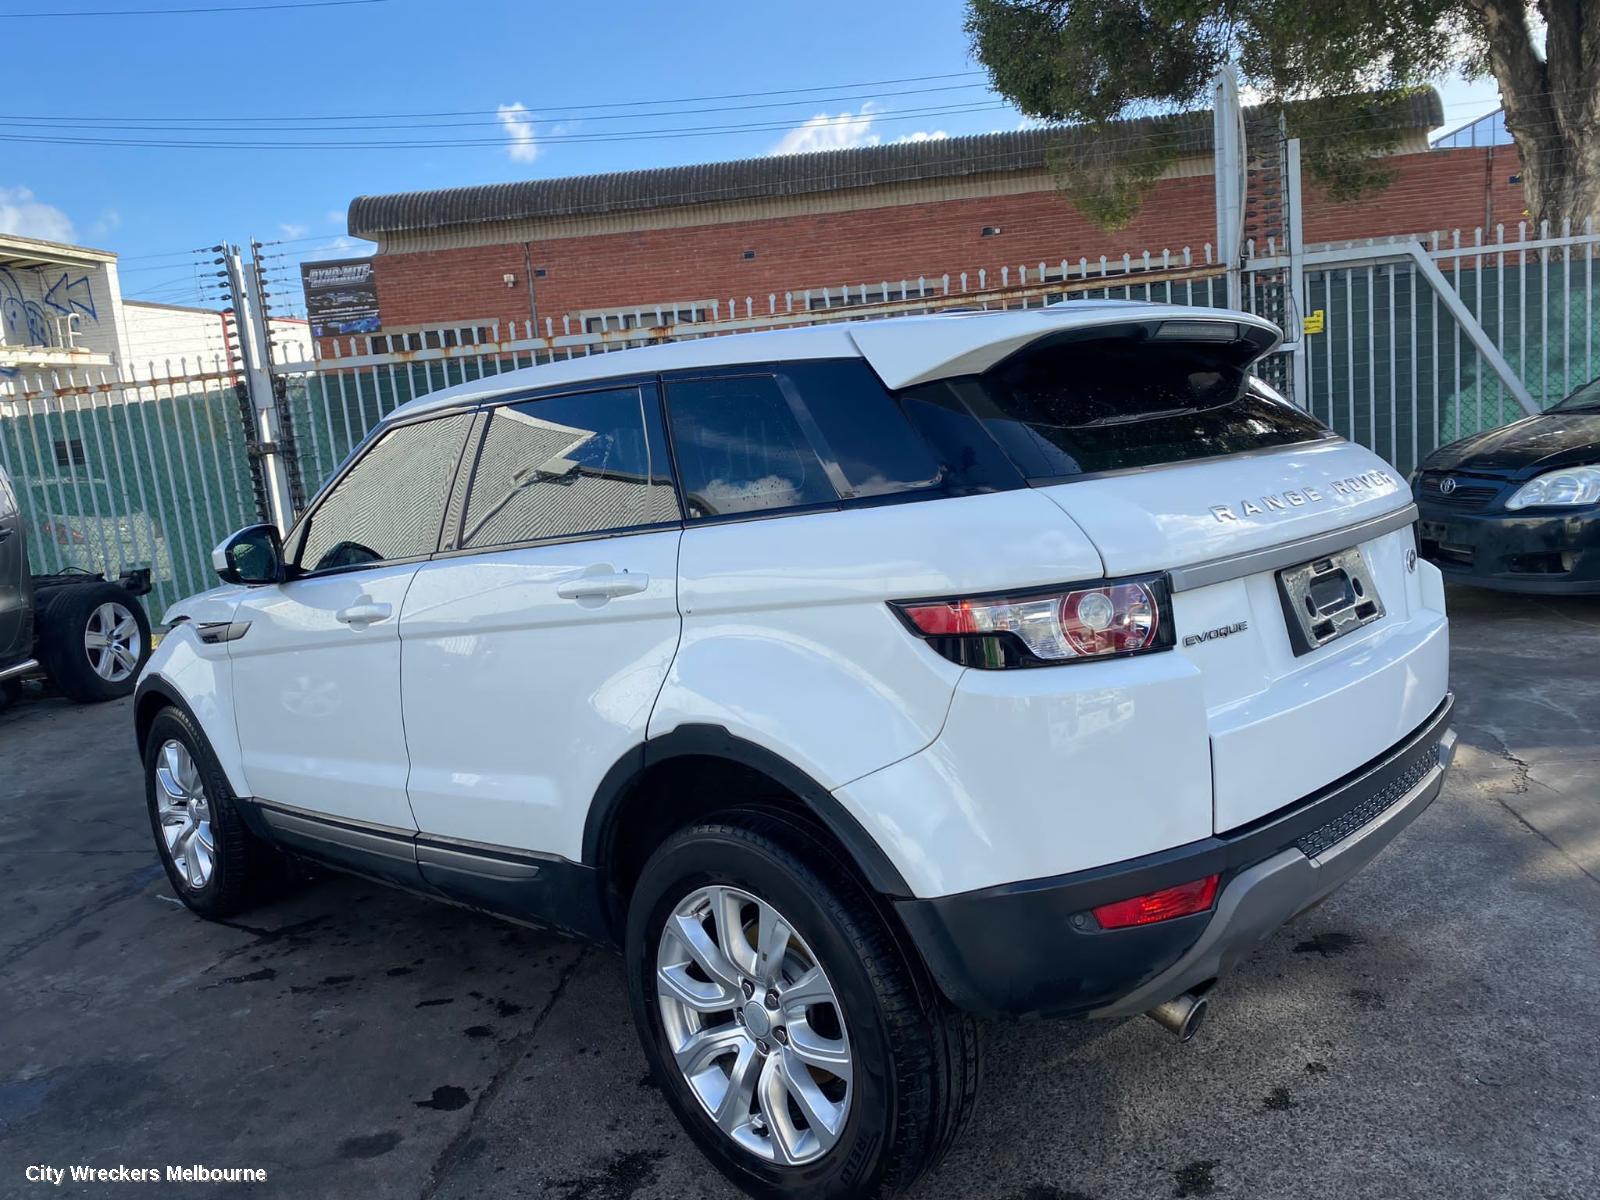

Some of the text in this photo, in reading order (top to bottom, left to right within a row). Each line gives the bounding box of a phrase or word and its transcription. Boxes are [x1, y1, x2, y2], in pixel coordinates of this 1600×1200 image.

[1208, 471, 1394, 523] RANGE ROVER
[1182, 620, 1249, 648] EVOQUE
